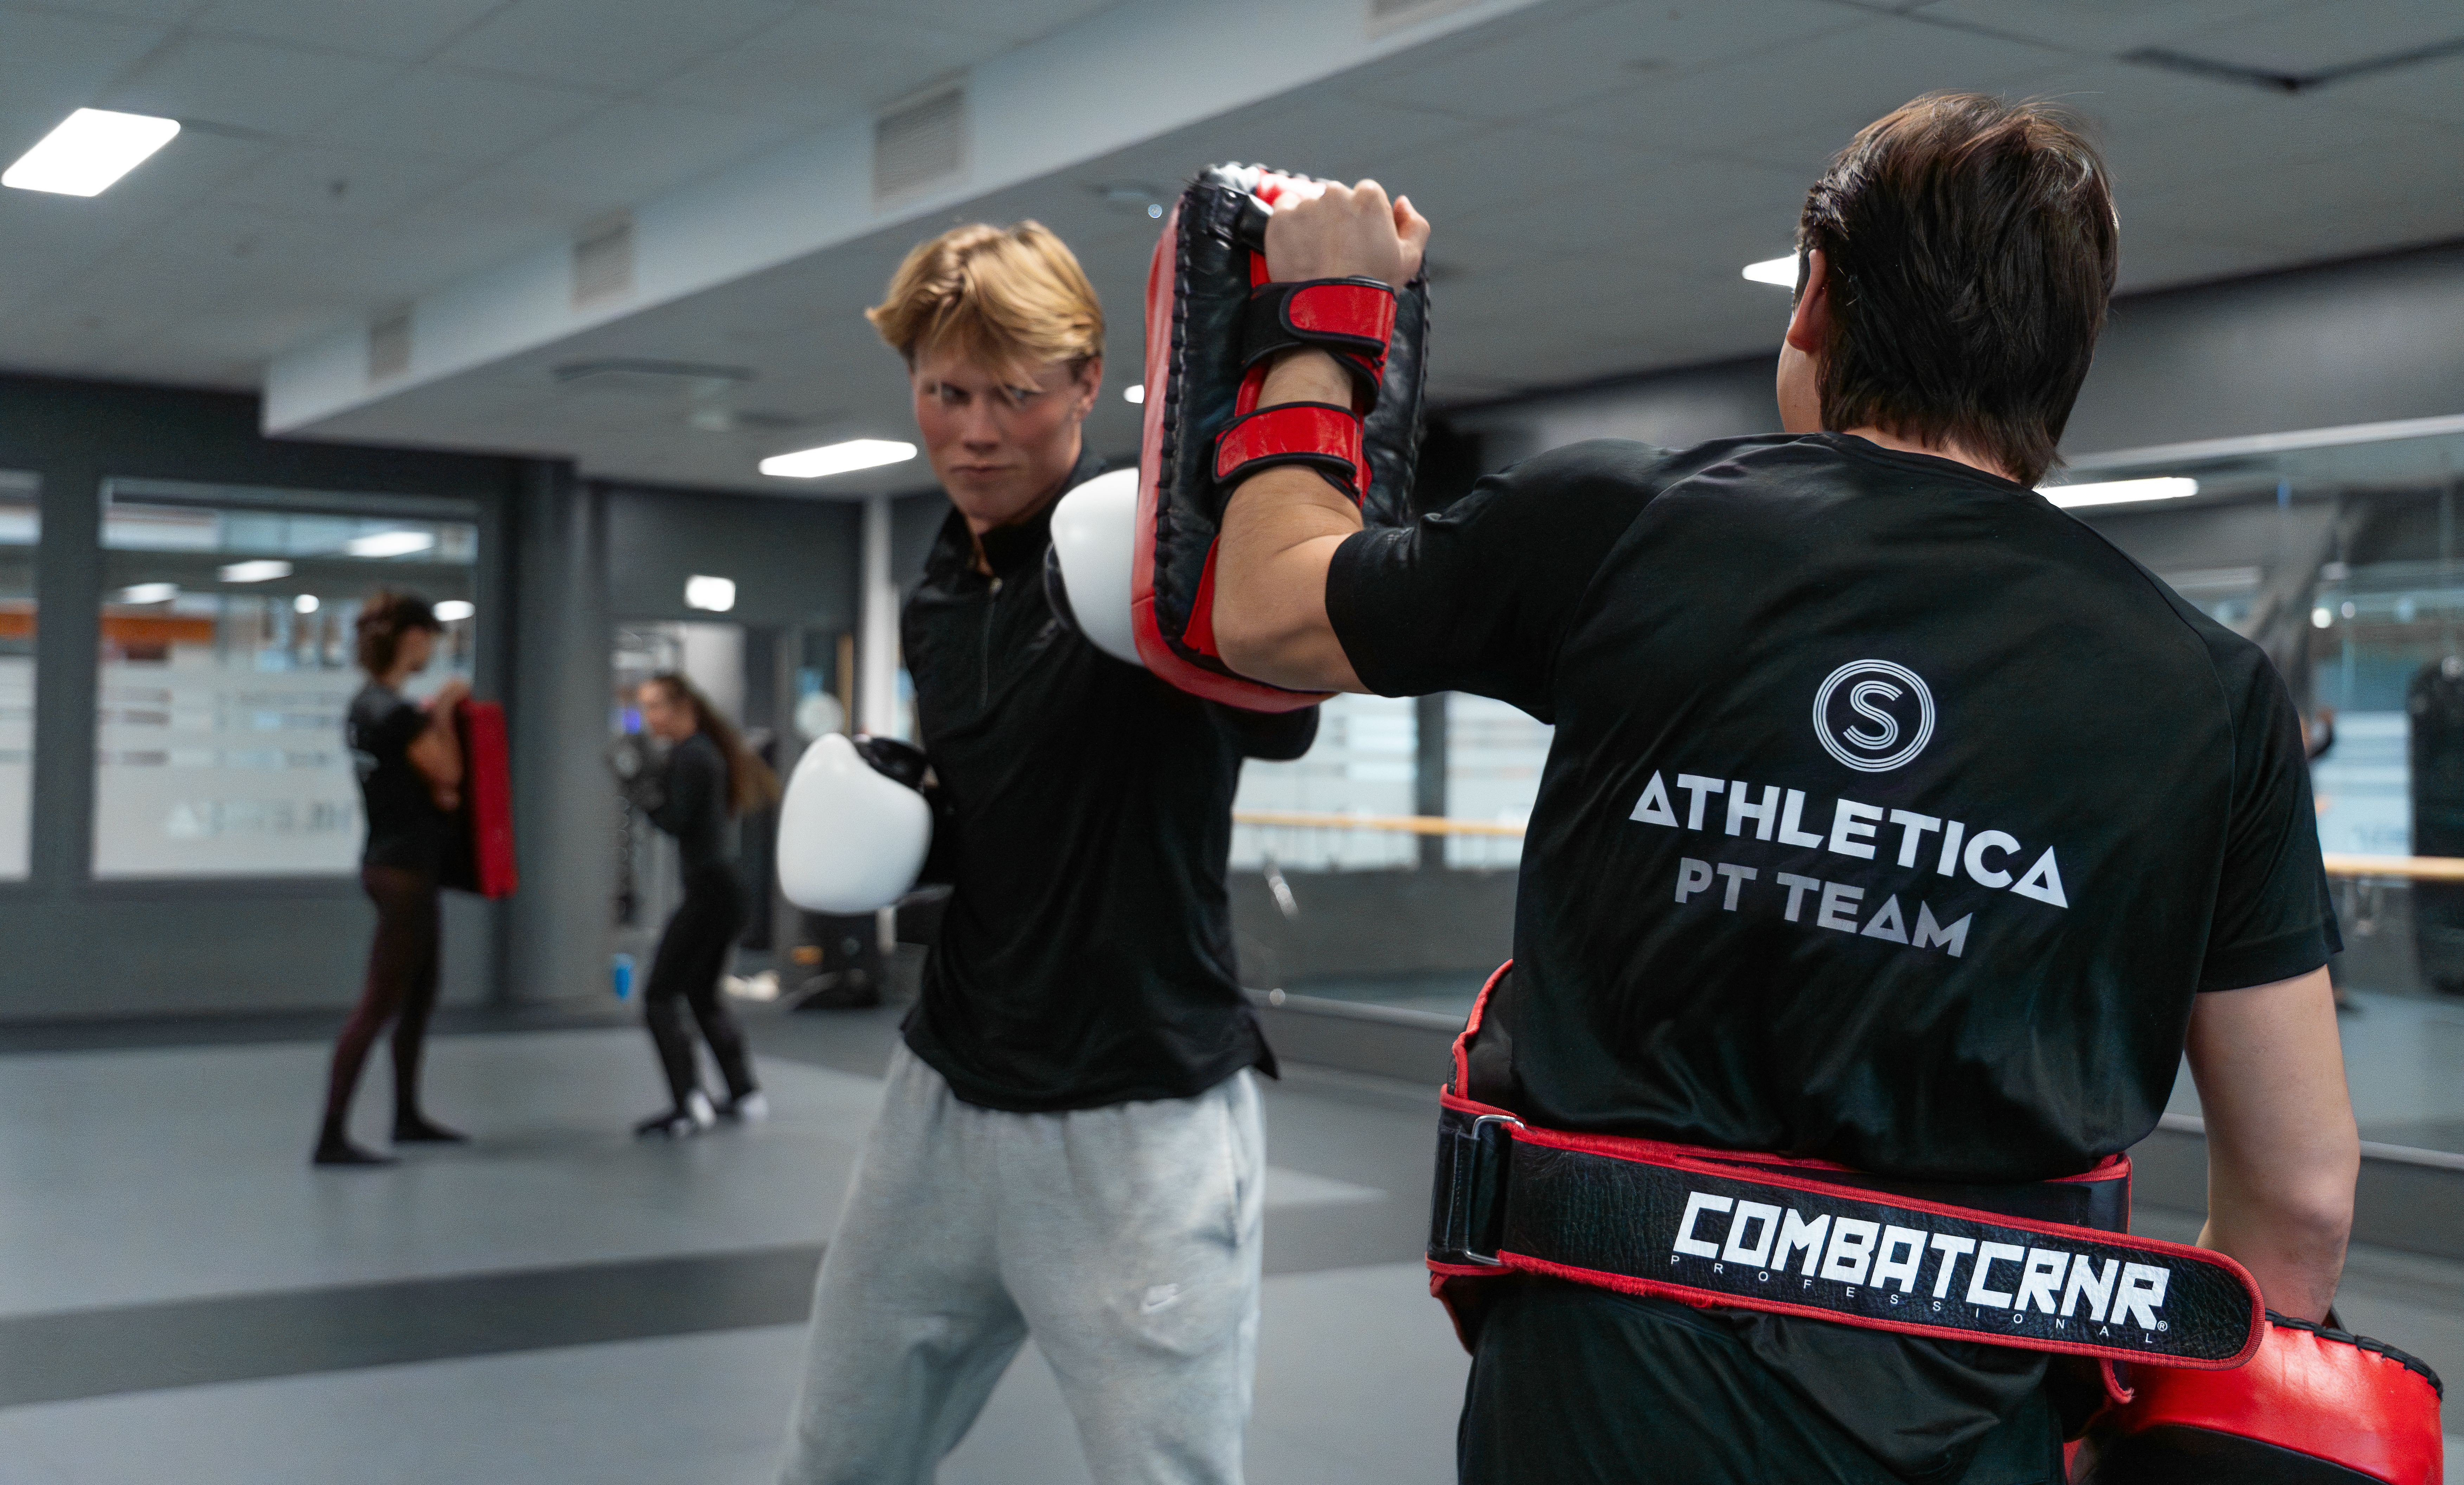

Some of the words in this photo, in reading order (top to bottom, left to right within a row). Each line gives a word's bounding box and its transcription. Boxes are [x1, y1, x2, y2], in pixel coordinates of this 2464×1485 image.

[1629, 770, 2068, 908] ATHLETICA
[1675, 857, 1757, 911] PT
[1777, 872, 1972, 957] TEAM
[1670, 1255, 2152, 1344] PROFESSIONAL
